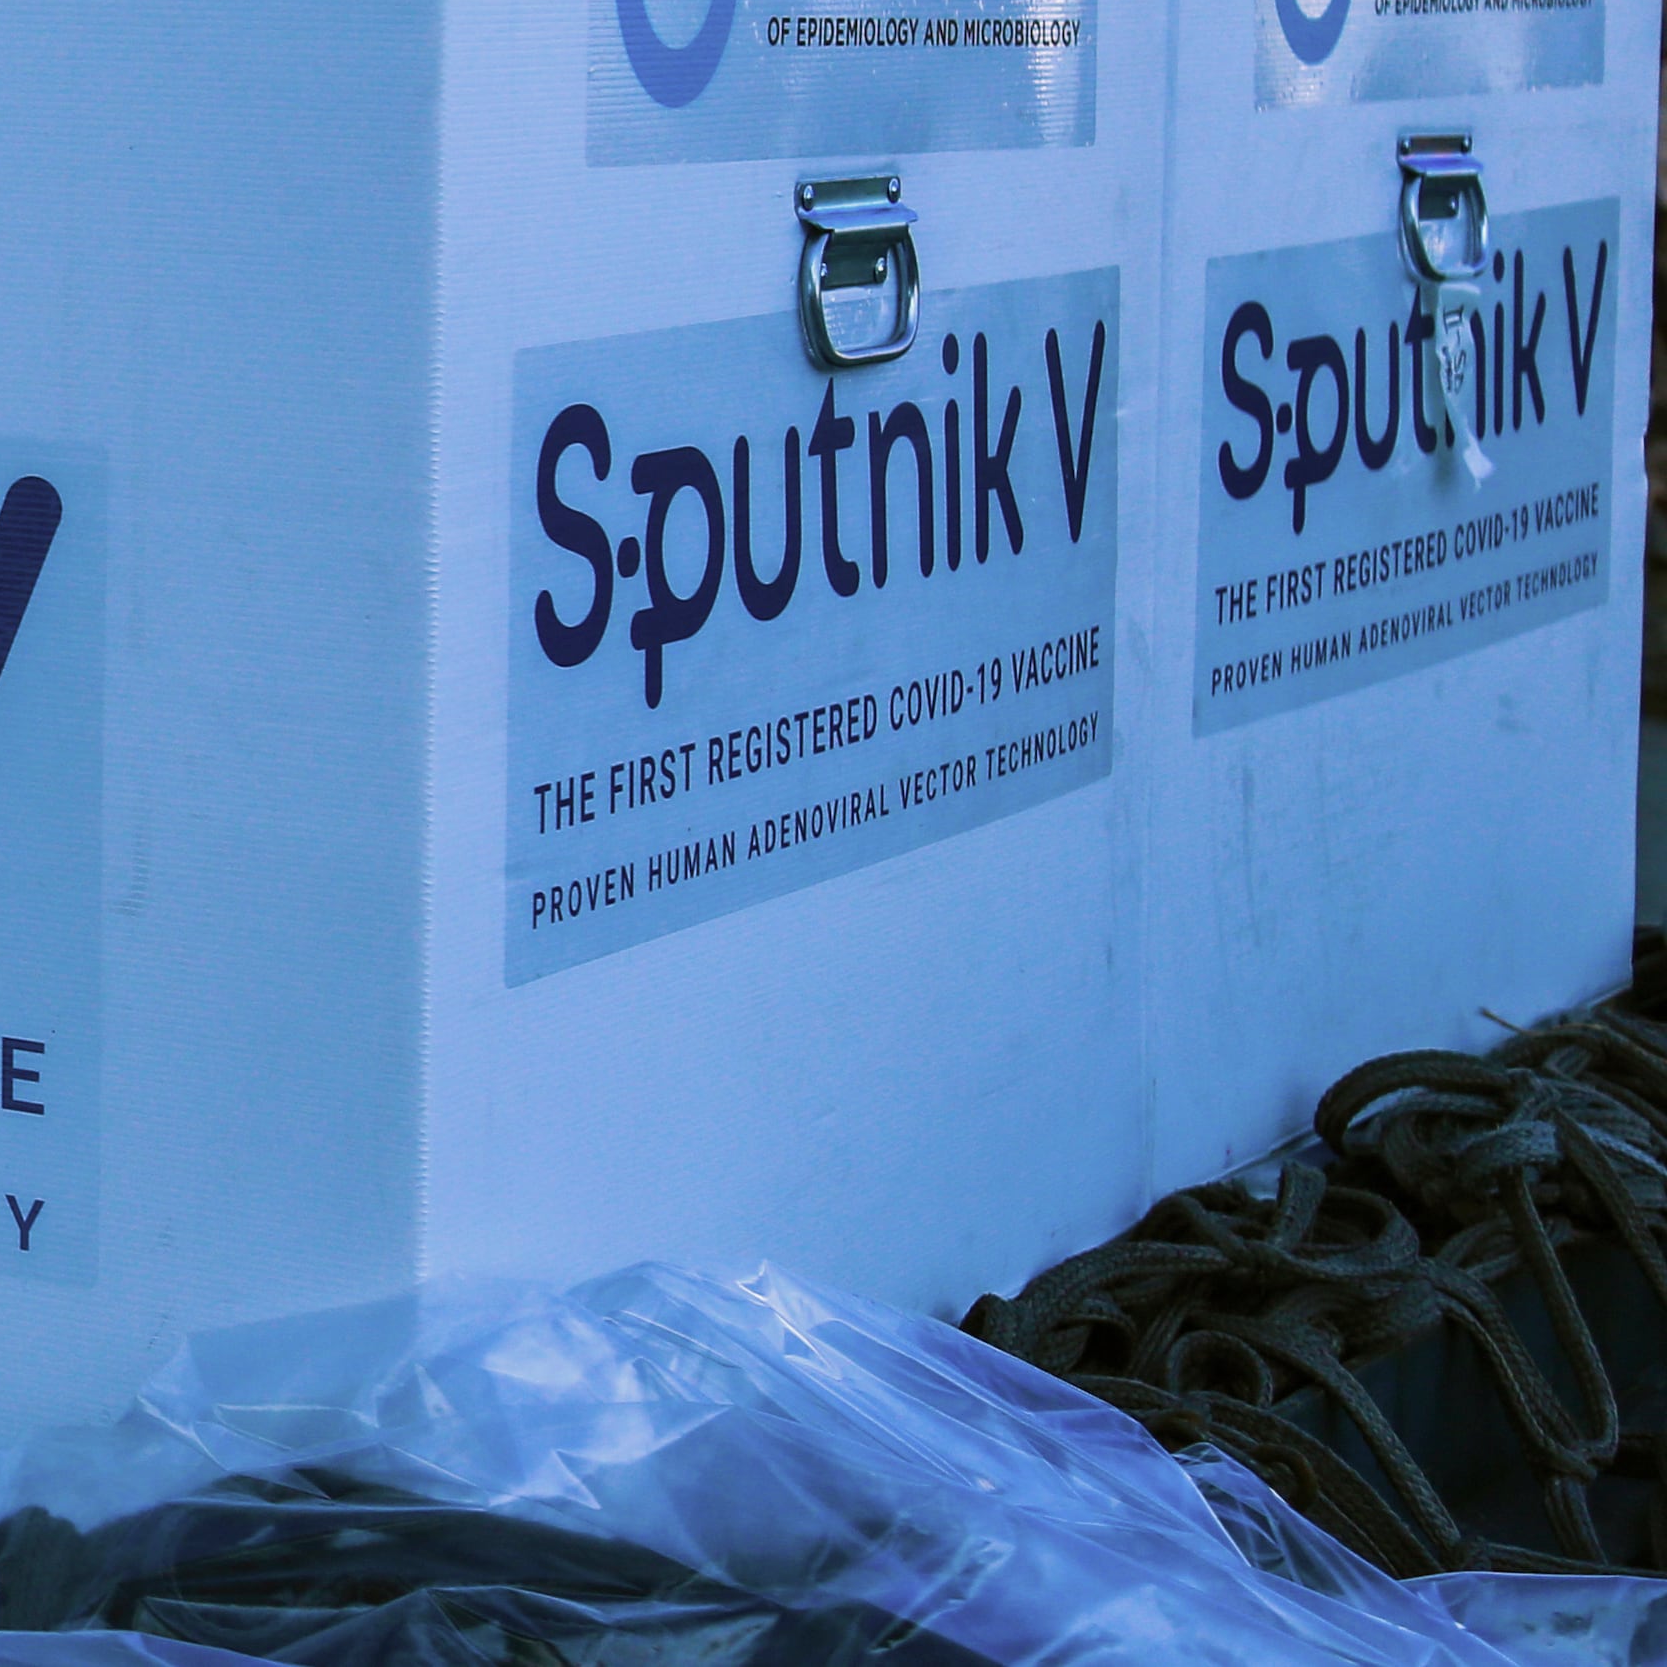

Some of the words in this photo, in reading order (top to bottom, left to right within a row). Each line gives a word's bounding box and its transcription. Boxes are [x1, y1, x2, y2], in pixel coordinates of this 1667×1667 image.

[768, 17, 790, 46] OF
[797, 17, 918, 46] EPIDEMIOLOGY
[924, 19, 958, 46] AND
[964, 19, 1081, 46] MICROBIOLOGY
[1563, 239, 1608, 417] V
[534, 332, 1024, 709] Sputnik
[1045, 319, 1106, 543] V
[1215, 579, 1257, 625] THE
[1267, 561, 1326, 614] FIRST
[1333, 530, 1447, 595] REGISTERED
[1454, 503, 1529, 559] COVID-19
[1535, 482, 1599, 532] VACCINE
[1211, 651, 1282, 697] PROVEN
[1290, 630, 1351, 676] HUMAN
[1359, 602, 1453, 655] ADENOVIRAL
[1460, 582, 1511, 622] VECTOR
[1516, 550, 1599, 603] TECHNOLOGY
[534, 771, 596, 834] THE
[609, 743, 696, 815] FIRST
[709, 694, 877, 785] REGISTERED
[890, 657, 1002, 732] COVID-19
[1012, 626, 1099, 694] VACCINE
[533, 863, 634, 929] PROVEN
[649, 830, 735, 893] HUMAN
[748, 784, 890, 860] ADENOVIRAL
[900, 755, 976, 811] VECTOR
[986, 711, 1099, 780] TECHNOLOGY
